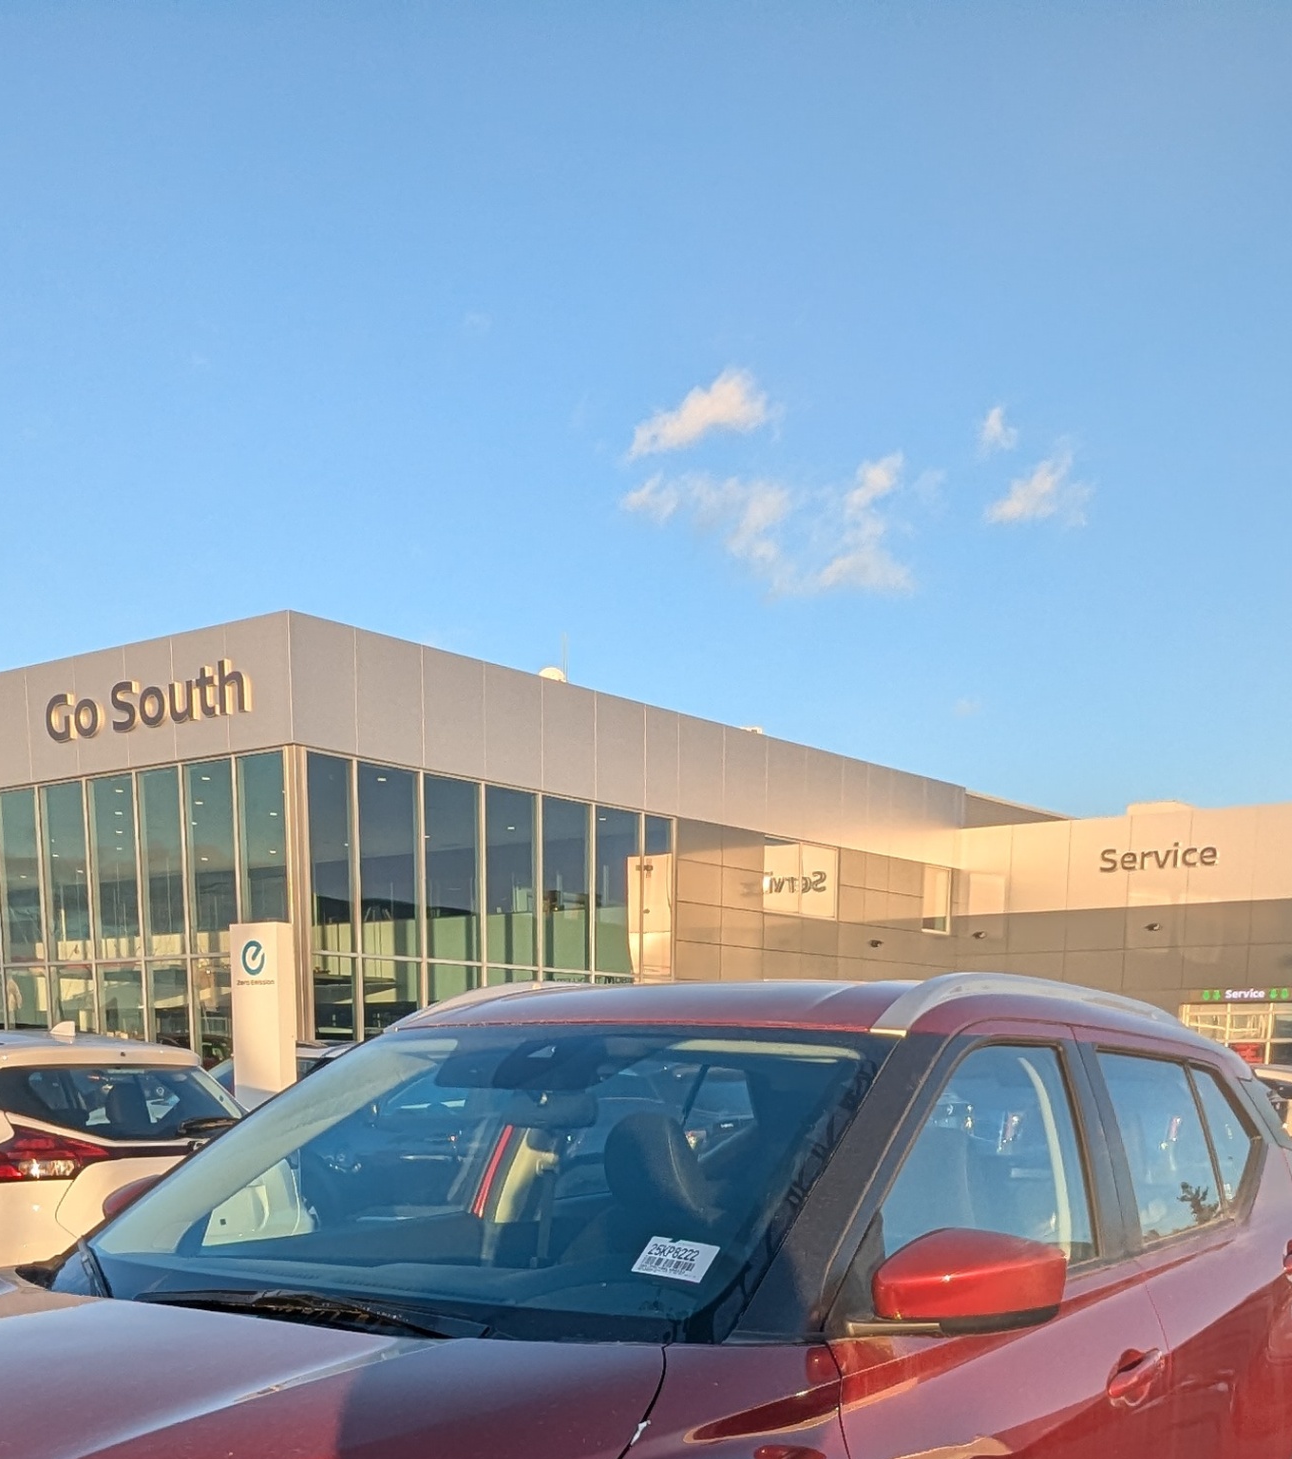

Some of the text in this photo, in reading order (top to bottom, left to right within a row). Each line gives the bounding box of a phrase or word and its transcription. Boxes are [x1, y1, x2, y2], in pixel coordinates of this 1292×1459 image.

[46, 657, 252, 743] Go South
[1099, 842, 1219, 873] Service
[1225, 988, 1265, 999] Service
[647, 1243, 699, 1262] 25KP8222
